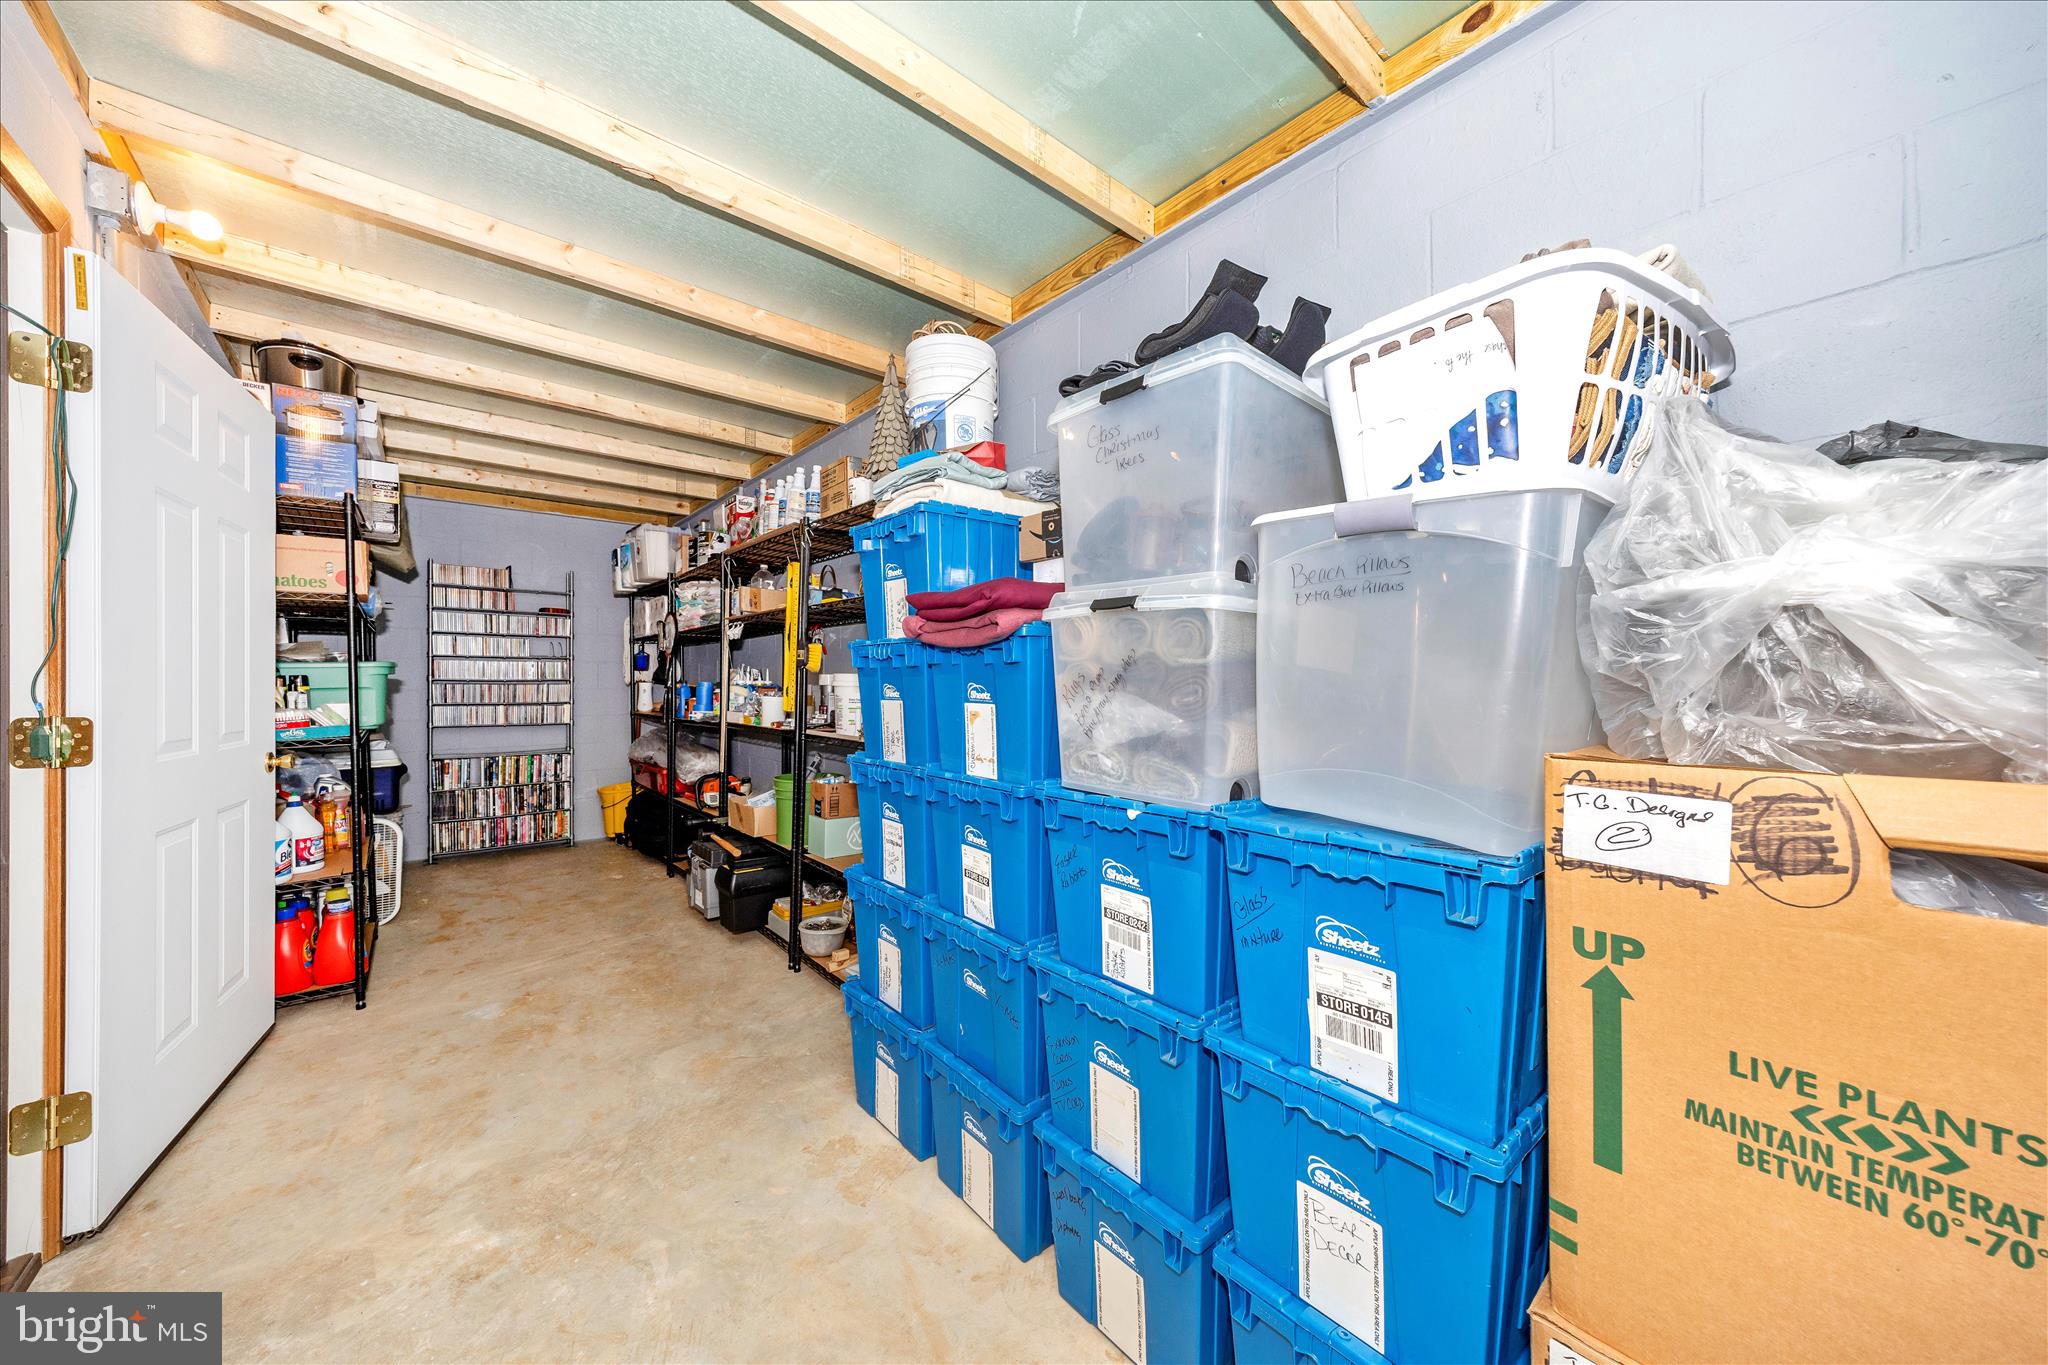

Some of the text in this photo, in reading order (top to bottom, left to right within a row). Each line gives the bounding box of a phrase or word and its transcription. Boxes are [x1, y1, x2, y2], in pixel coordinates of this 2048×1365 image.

[242, 381, 265, 390] BECKER
[1106, 907, 1146, 931] STORE 0242
[1321, 927, 1382, 959] Sheetz
[1572, 926, 1645, 967] UP
[1320, 994, 1391, 1027] STORE 0145
[1097, 1050, 1132, 1078] Sheetz
[1729, 1050, 2048, 1168] LIVE PLANTS
[1313, 1167, 1373, 1213] Sheetz
[1684, 1098, 2046, 1241] MAINTAIN TEMPERAT
[1736, 1141, 1890, 1218] BETWEEN
[1309, 1196, 1364, 1242] BEAR
